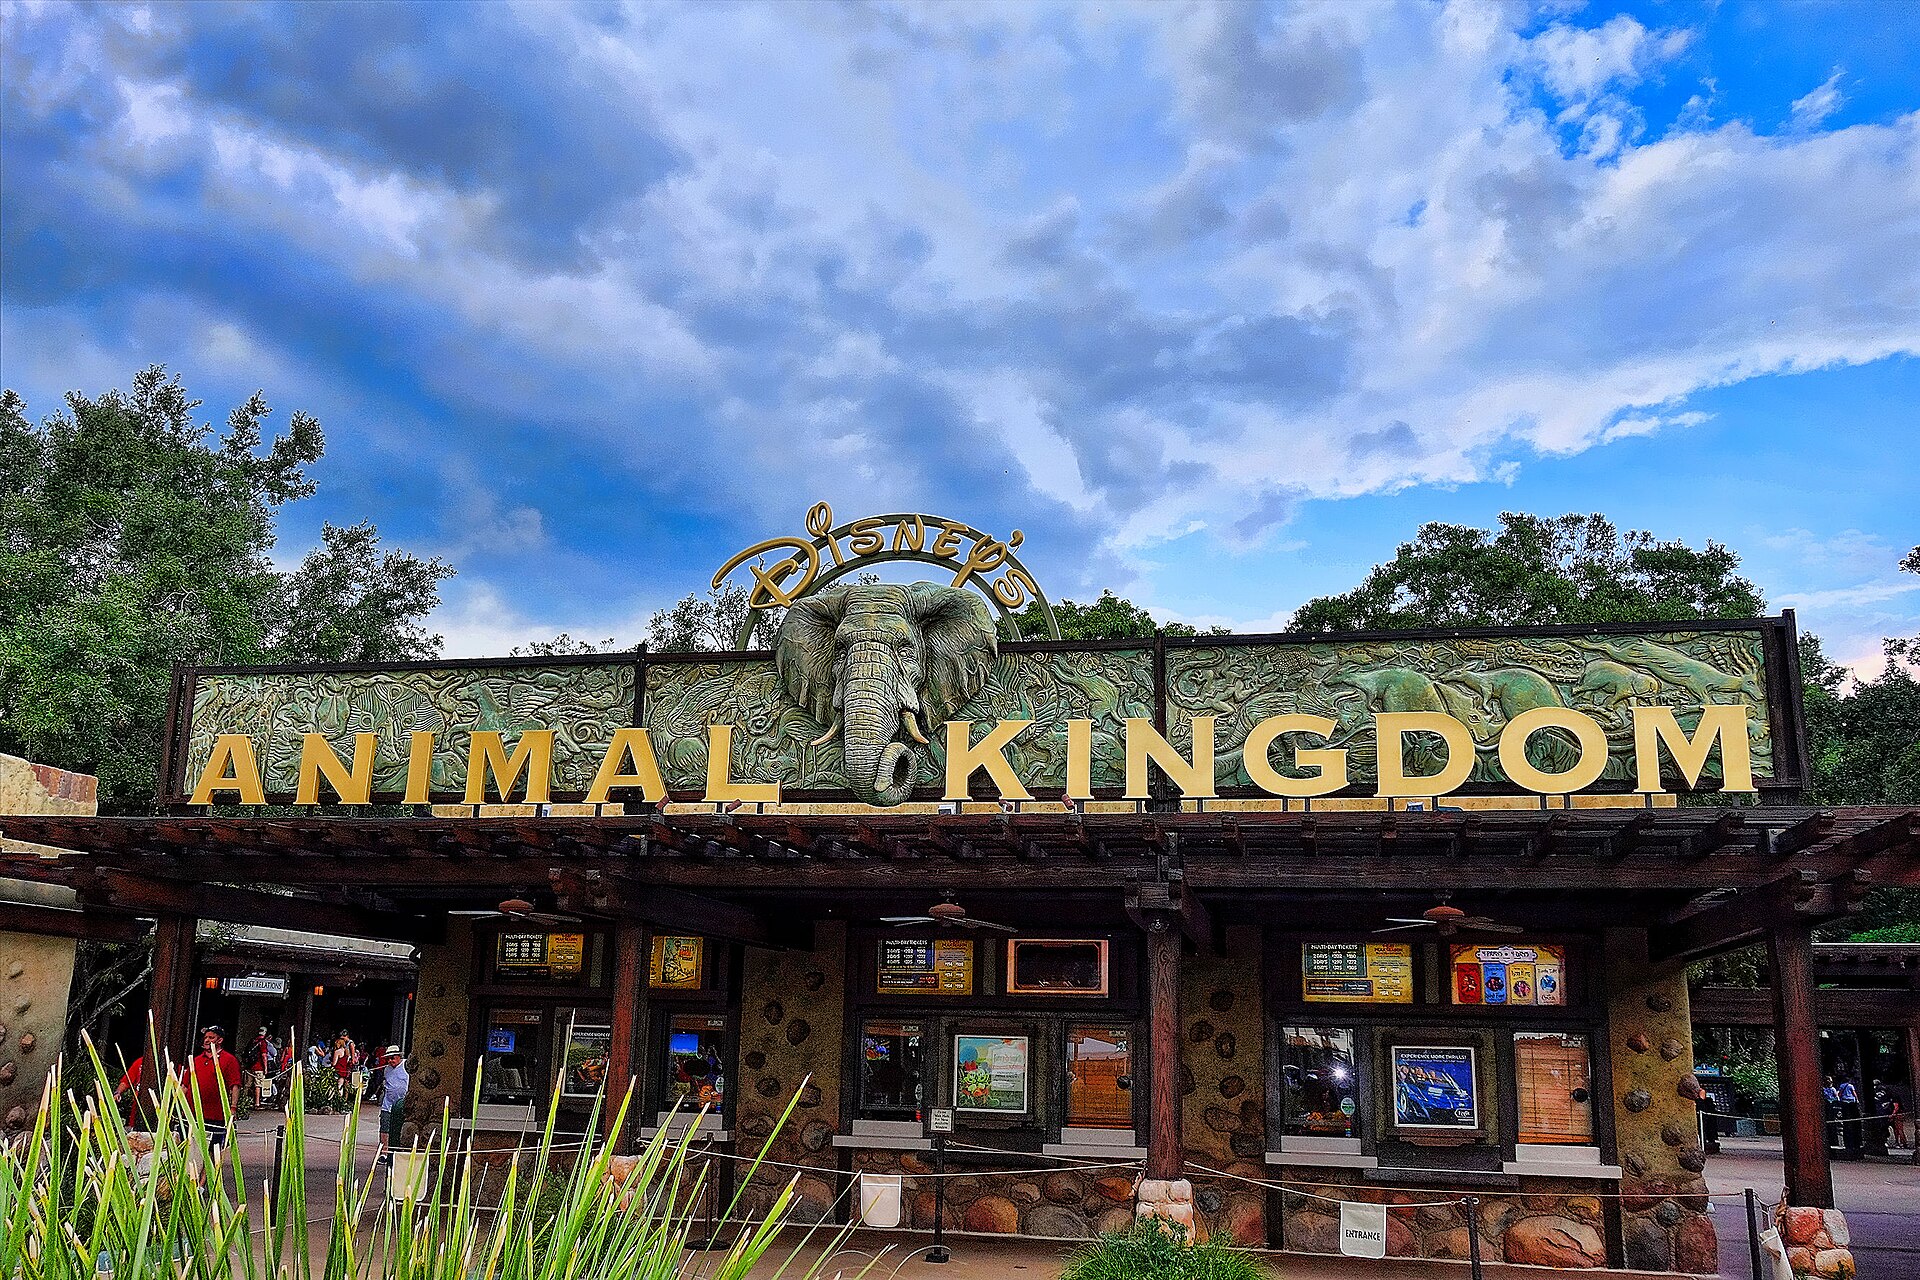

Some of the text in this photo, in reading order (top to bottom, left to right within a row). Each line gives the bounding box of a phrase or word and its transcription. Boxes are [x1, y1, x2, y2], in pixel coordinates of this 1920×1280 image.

[186, 704, 1759, 806] ANIMAL KINGDOM
[256, 981, 281, 989] RELATIONS
[1345, 1229, 1380, 1241] ENTRANCE
